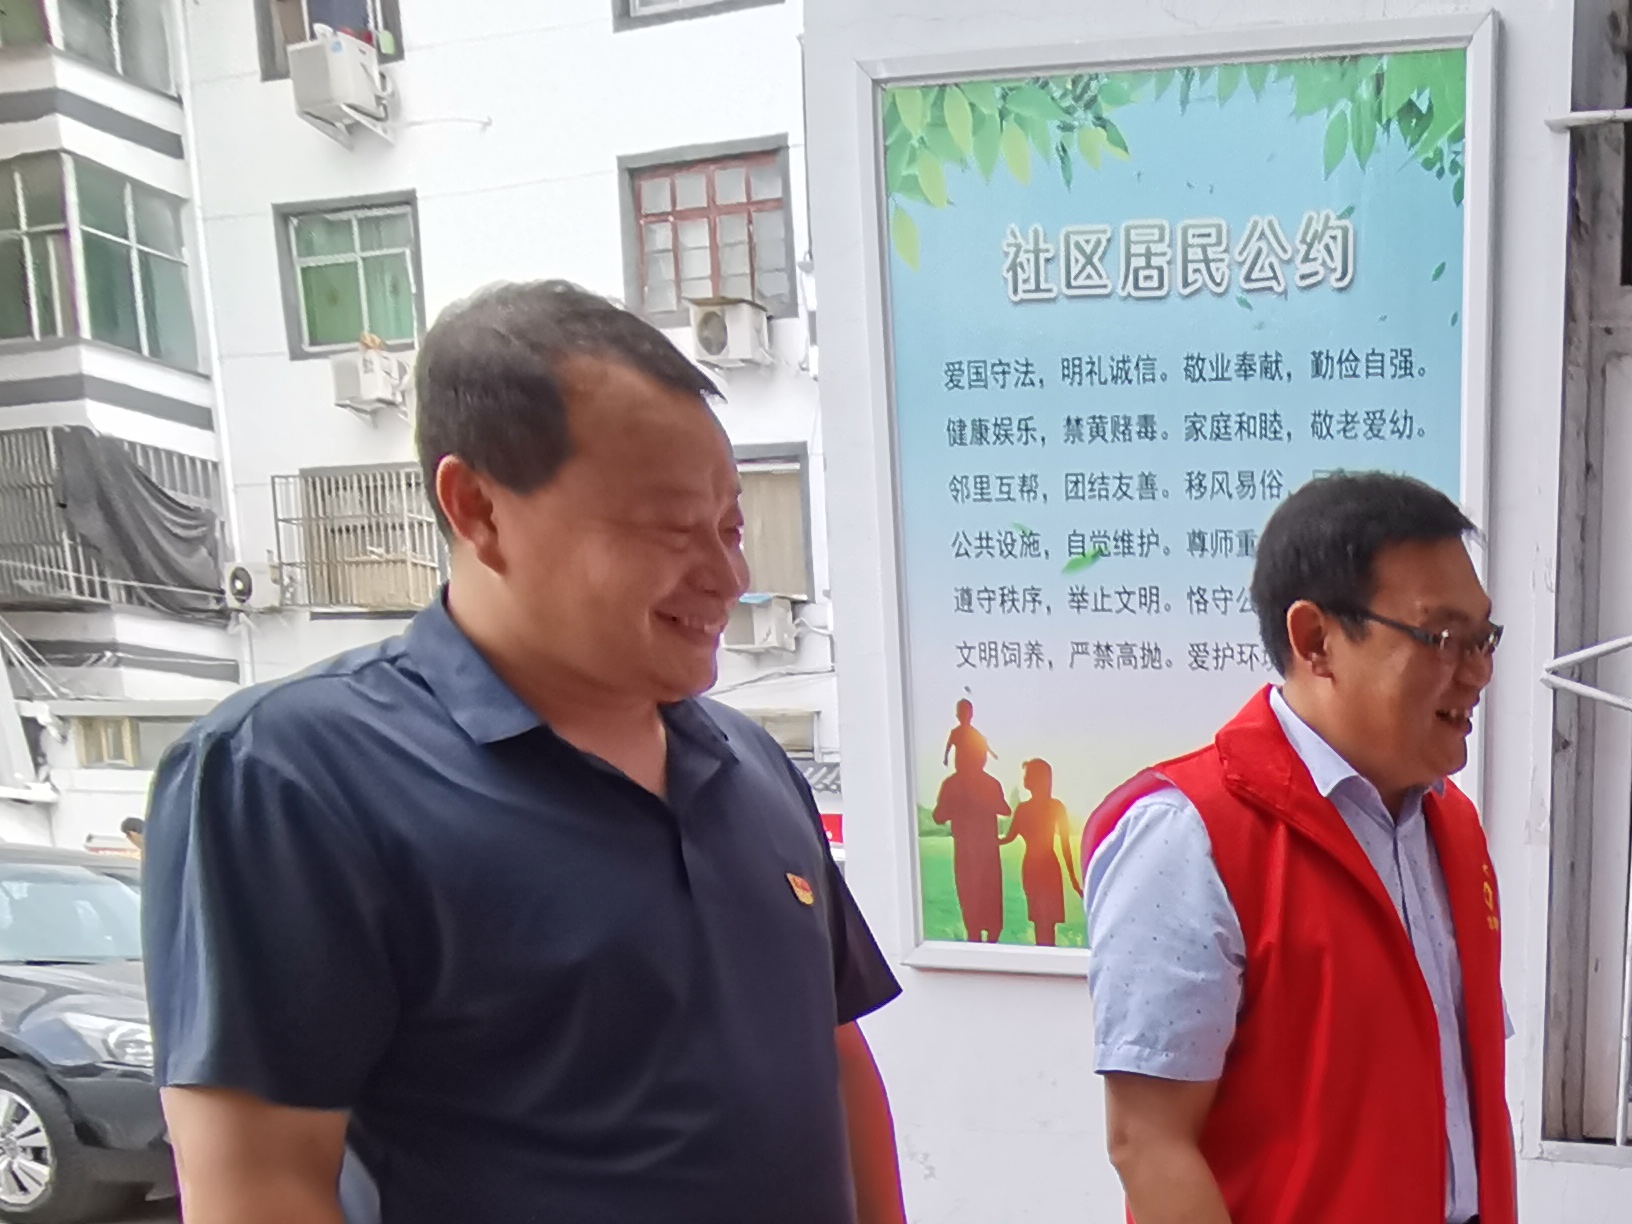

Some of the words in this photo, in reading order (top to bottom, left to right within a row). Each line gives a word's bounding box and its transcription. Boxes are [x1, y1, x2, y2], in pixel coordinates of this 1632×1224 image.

[1002, 210, 1355, 302] 社区居民公约
